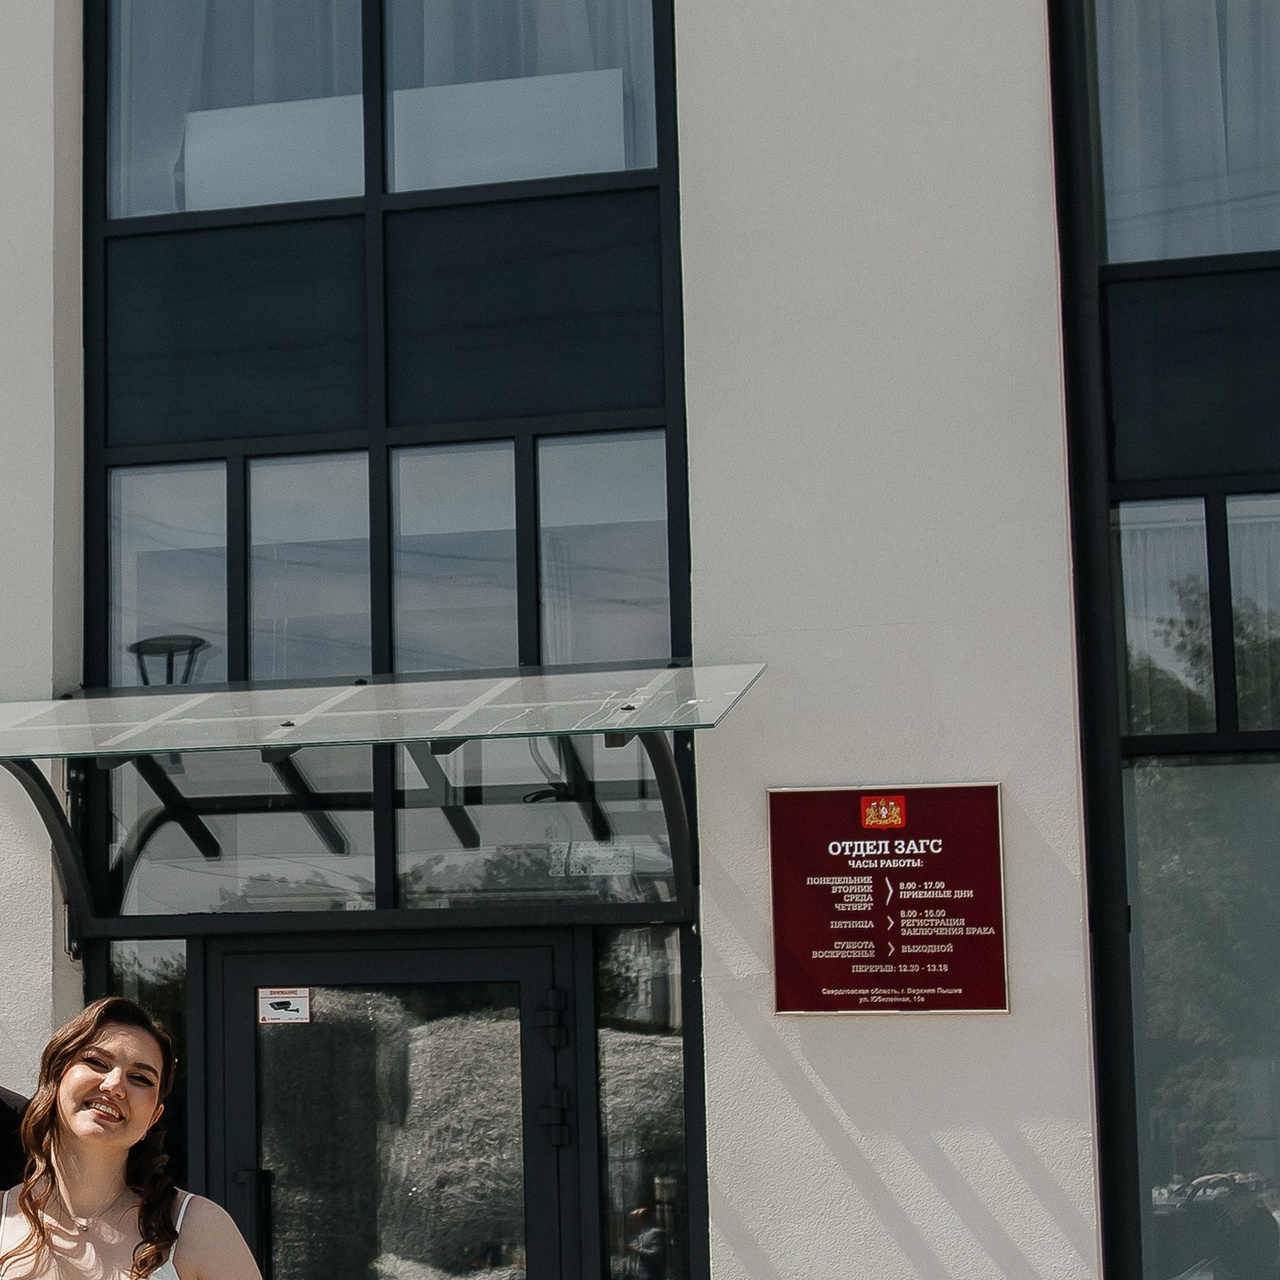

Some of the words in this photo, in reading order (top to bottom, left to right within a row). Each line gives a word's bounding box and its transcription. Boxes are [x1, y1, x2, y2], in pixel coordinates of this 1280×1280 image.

[828, 840, 890, 857] ОТДЕЛ
[894, 839, 943, 855] ЗАГС
[848, 859, 878, 868] ЧАСЫ
[879, 858, 924, 868] РАБОТЫ:
[806, 876, 873, 886] ПОНЕДЕЛЬНИК
[899, 882, 916, 890] 8.00
[923, 881, 945, 889] 17.00
[831, 885, 873, 894] ВТОРНИК
[843, 894, 873, 903] СРЕДА
[899, 890, 952, 899] ПРИЕМНЫЕ
[954, 890, 974, 899] ДНИ
[834, 903, 874, 911] ЧЕТВЕРГ
[900, 910, 917, 918] 8.00
[830, 921, 874, 929] ПЯТНИЦА
[901, 918, 965, 927] РЕГИСТРАЦИЯ
[901, 927, 964, 936] ЗАКЛЮЧЕНИЯ
[966, 926, 995, 935] БРАКА
[901, 943, 954, 953] ВЫХОДНОЙ
[812, 950, 875, 959] ВОСКРЕСЕНЬЕ
[851, 964, 896, 973] ПЕРЕРЫВ:
[898, 964, 920, 972] 12.30
